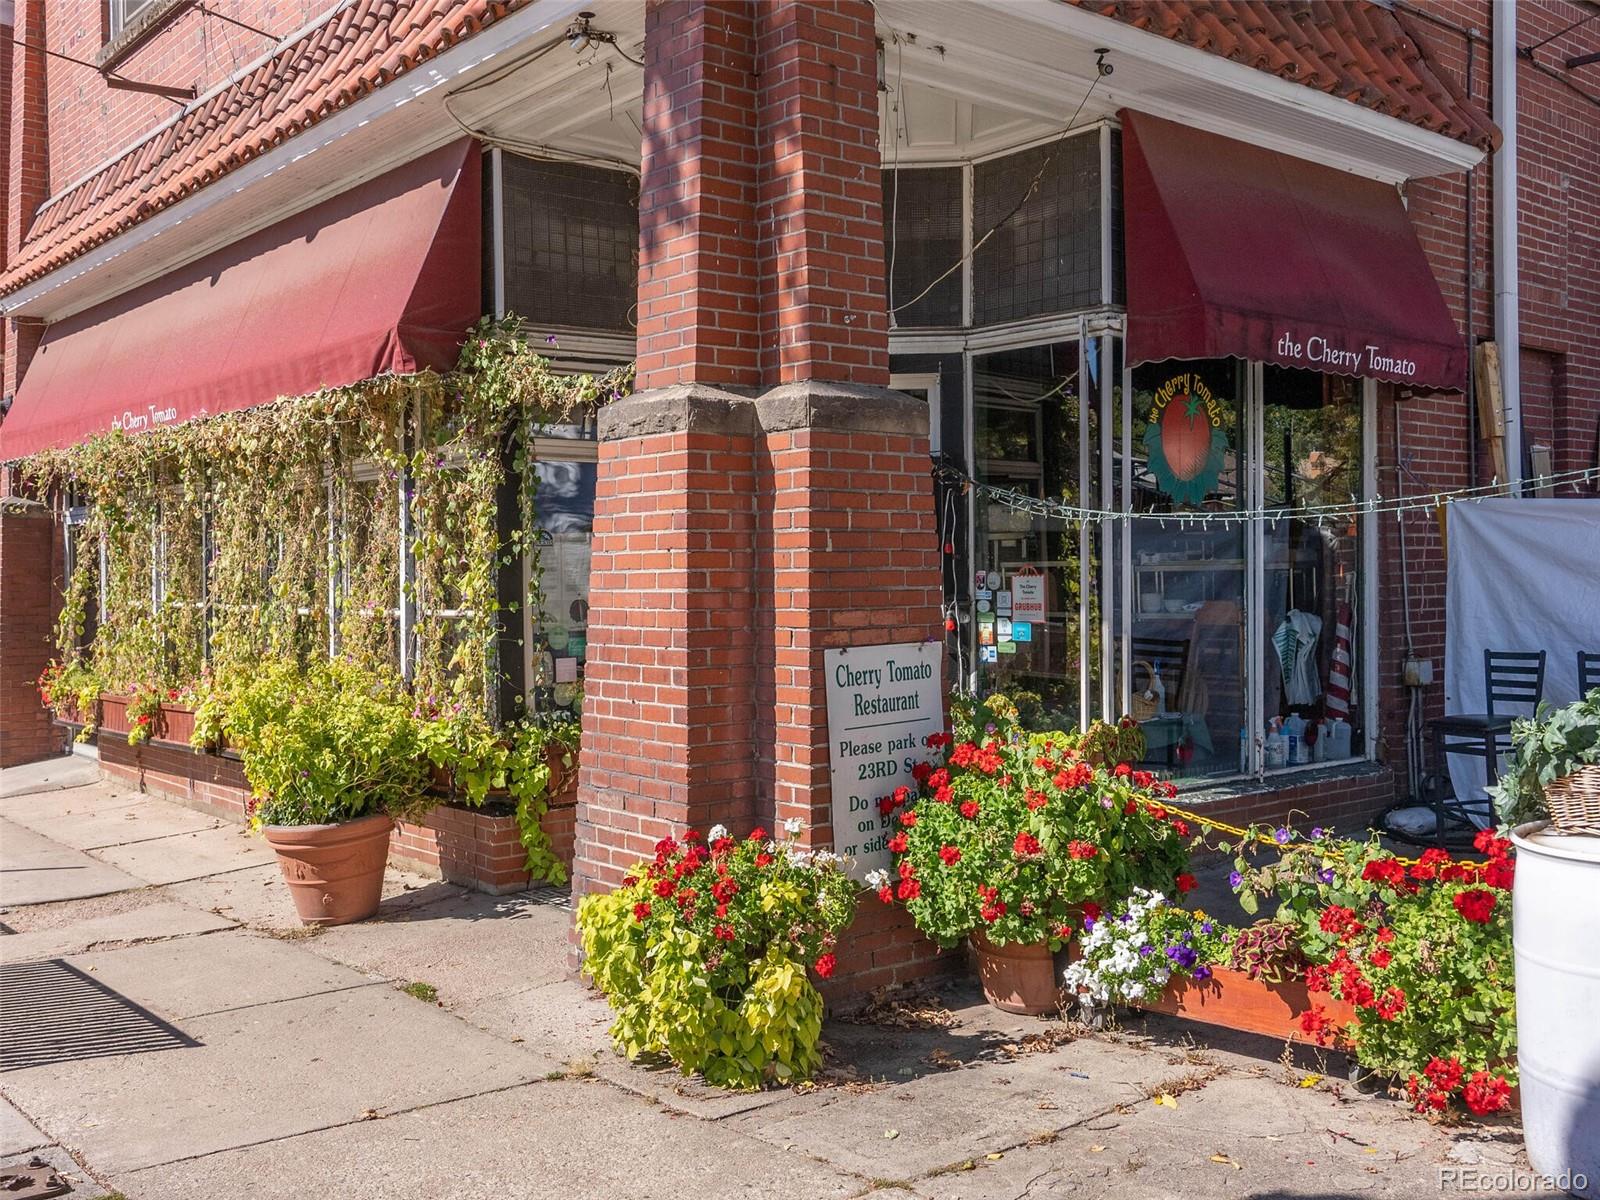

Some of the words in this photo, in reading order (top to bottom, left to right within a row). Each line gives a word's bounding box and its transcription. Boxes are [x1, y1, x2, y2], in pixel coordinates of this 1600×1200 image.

[1278, 332, 1302, 358] the
[1307, 336, 1362, 373] Cherry
[1365, 345, 1416, 376] Tomato
[1149, 407, 1159, 424] the
[1154, 373, 1191, 408] Cherry
[1193, 373, 1221, 427] Tomato
[123, 411, 148, 430] Cherry
[149, 405, 177, 424] Tomato
[1014, 602, 1042, 611] GRUBHUB
[835, 662, 882, 690] Cherry
[887, 660, 932, 683] Tomato
[854, 690, 920, 716] Restaurant
[839, 740, 883, 757] Please
[888, 732, 916, 755] park
[858, 759, 898, 781] 23RD
[849, 795, 869, 812] Do
[857, 819, 875, 833] on
[844, 844, 858, 857] or
